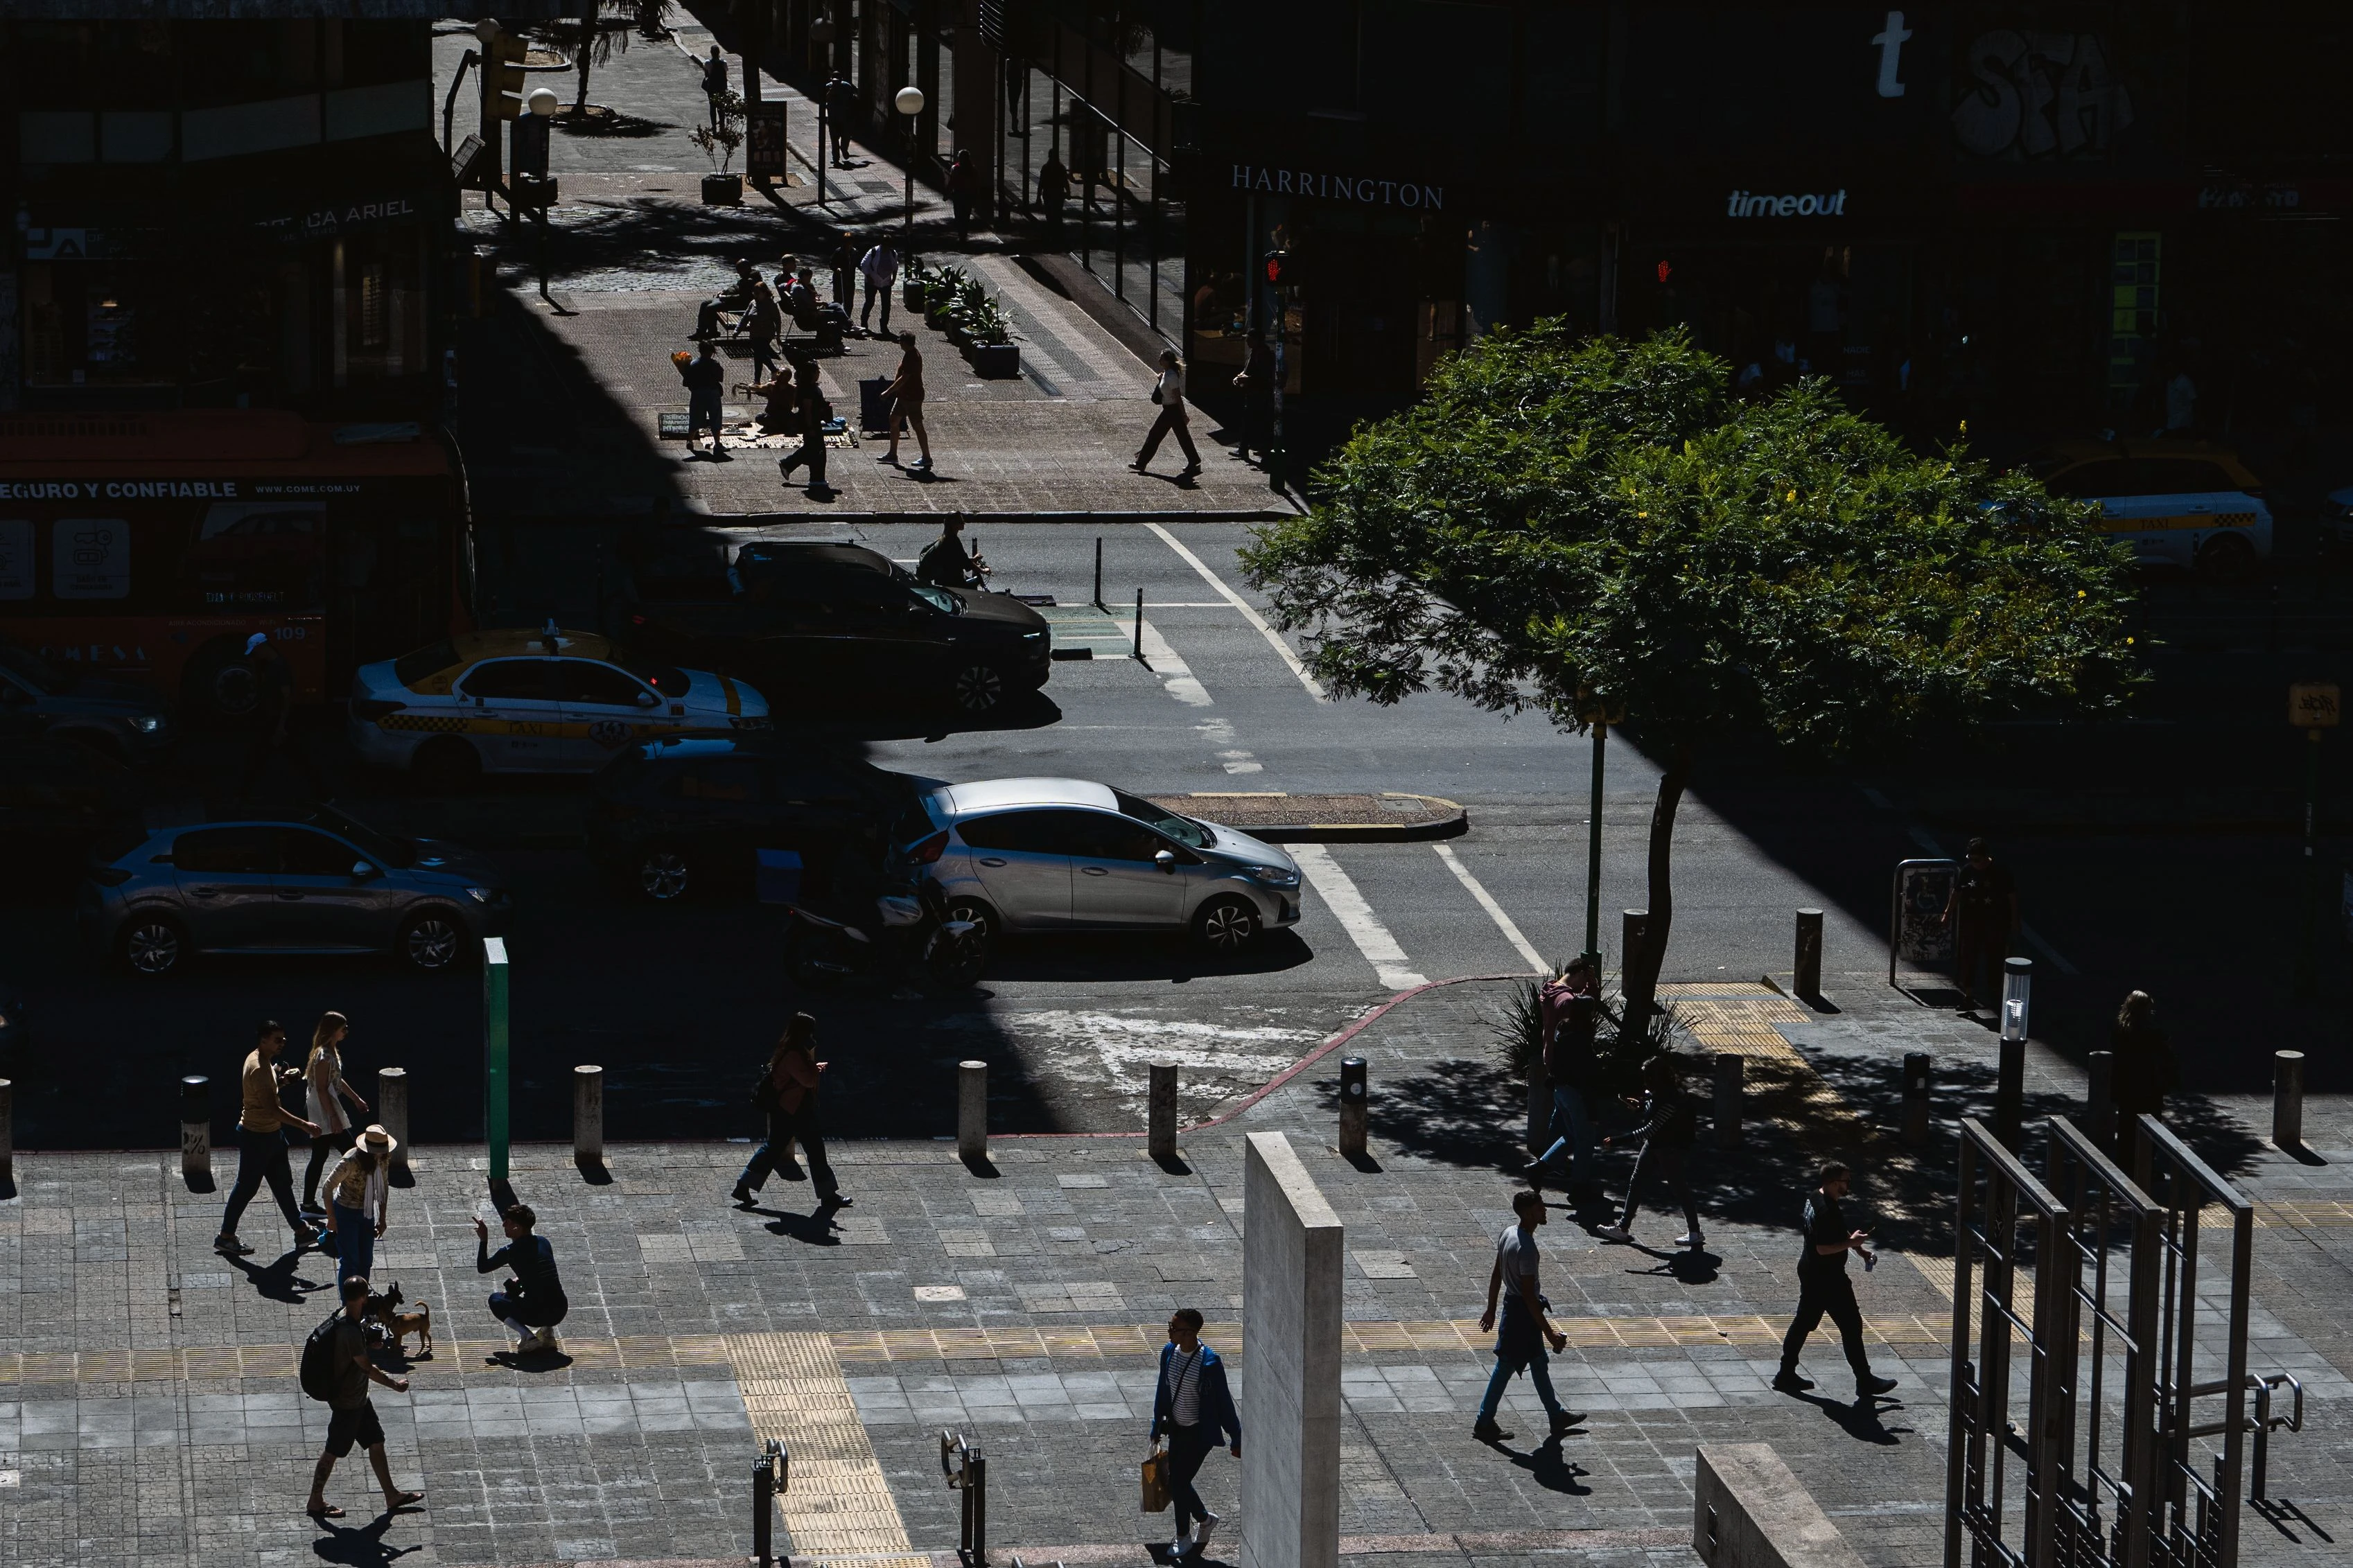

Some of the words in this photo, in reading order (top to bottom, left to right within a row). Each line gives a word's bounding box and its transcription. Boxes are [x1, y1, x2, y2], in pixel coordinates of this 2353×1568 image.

[1870, 10, 1913, 98] t
[1232, 164, 1444, 210] HARRINGTON
[346, 200, 414, 222] ARIEL
[1726, 188, 1848, 217] timeout
[83, 483, 100, 498] Y
[105, 482, 238, 498] CONFIABLE
[2140, 518, 2170, 530] TAXI
[274, 626, 306, 641] 109
[507, 722, 543, 735] TAXI
